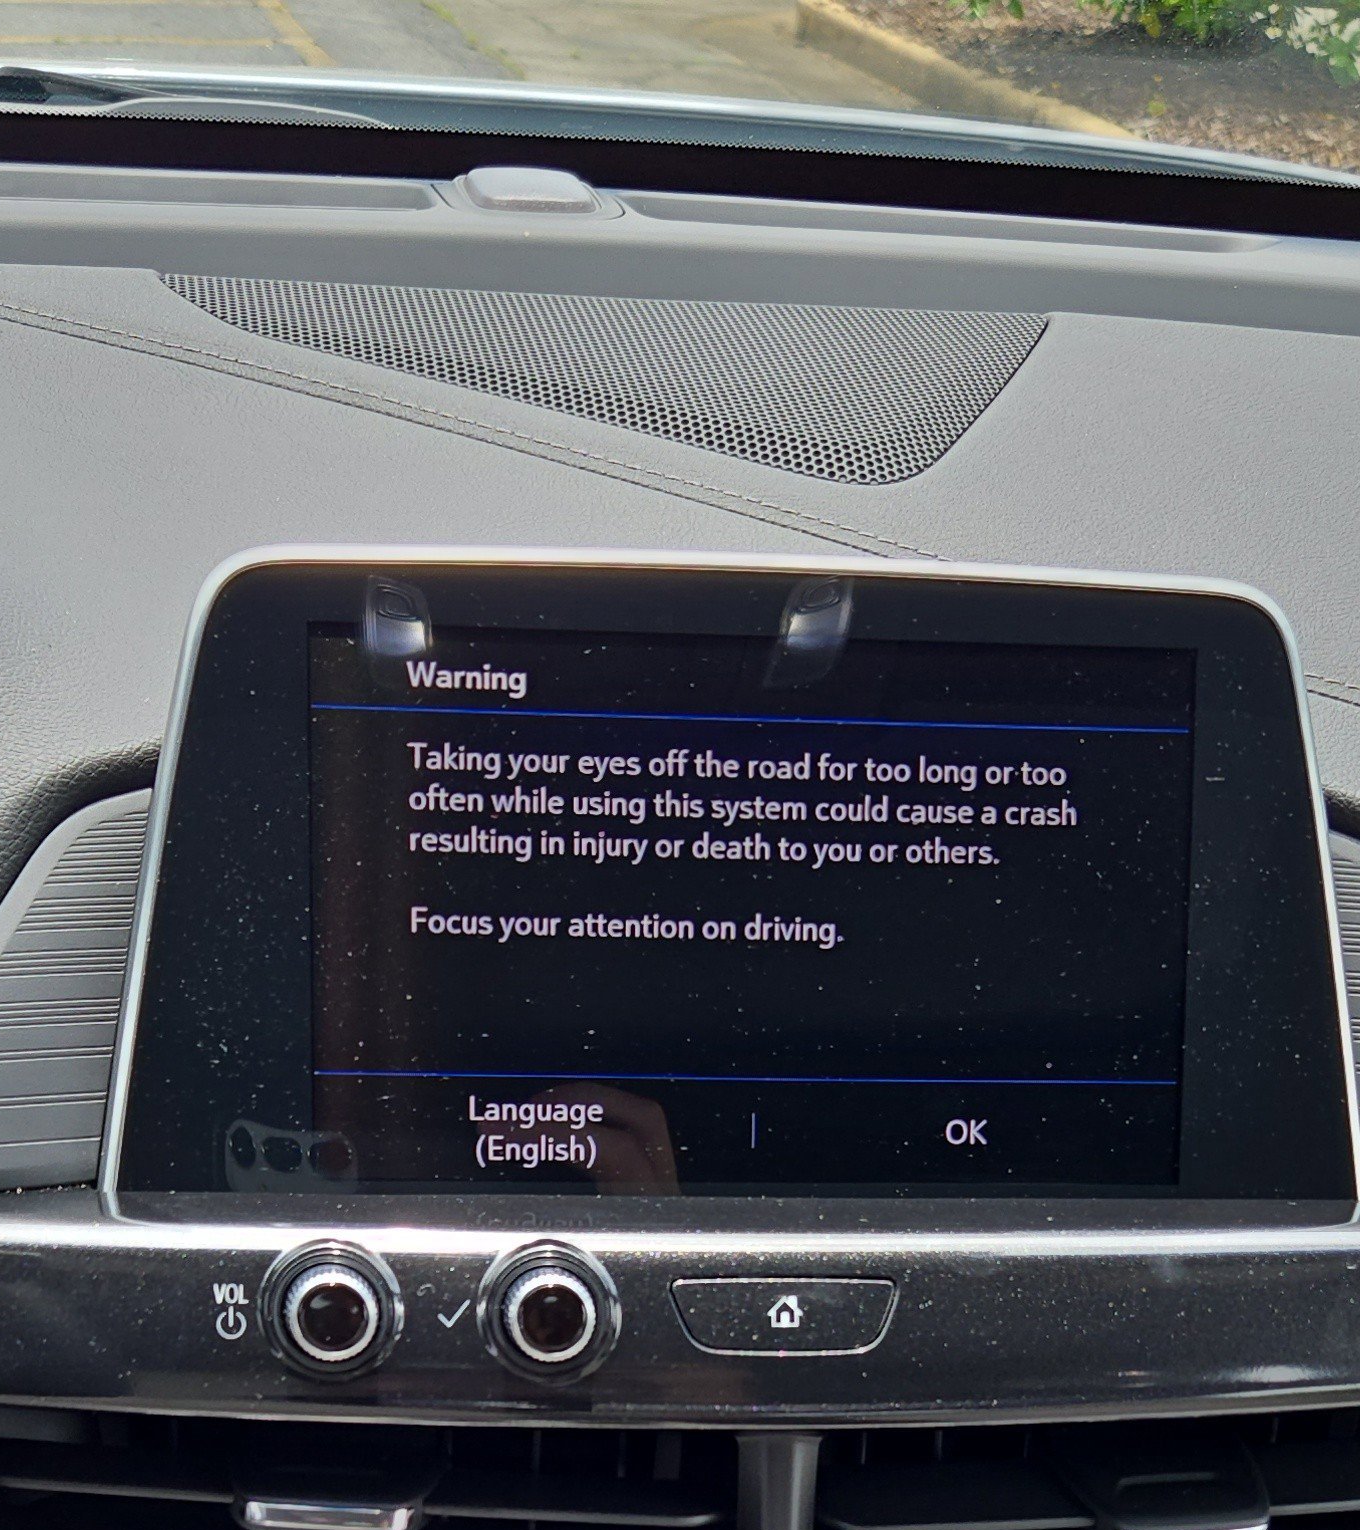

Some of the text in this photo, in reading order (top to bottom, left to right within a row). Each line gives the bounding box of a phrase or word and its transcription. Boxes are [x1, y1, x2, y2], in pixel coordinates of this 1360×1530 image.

[406, 660, 528, 699] Warning
[406, 741, 1067, 792] Taking your eyes off the road for too long or too
[408, 783, 1077, 827] often while using this system could cause a crash
[408, 825, 1001, 869] resulting in injury or death to you or others.
[410, 906, 845, 950] Focus your attention on driving.
[469, 1095, 604, 1130] Language
[945, 1119, 988, 1145] OK
[476, 1134, 597, 1169] (English)
[213, 1283, 249, 1305] VOL
